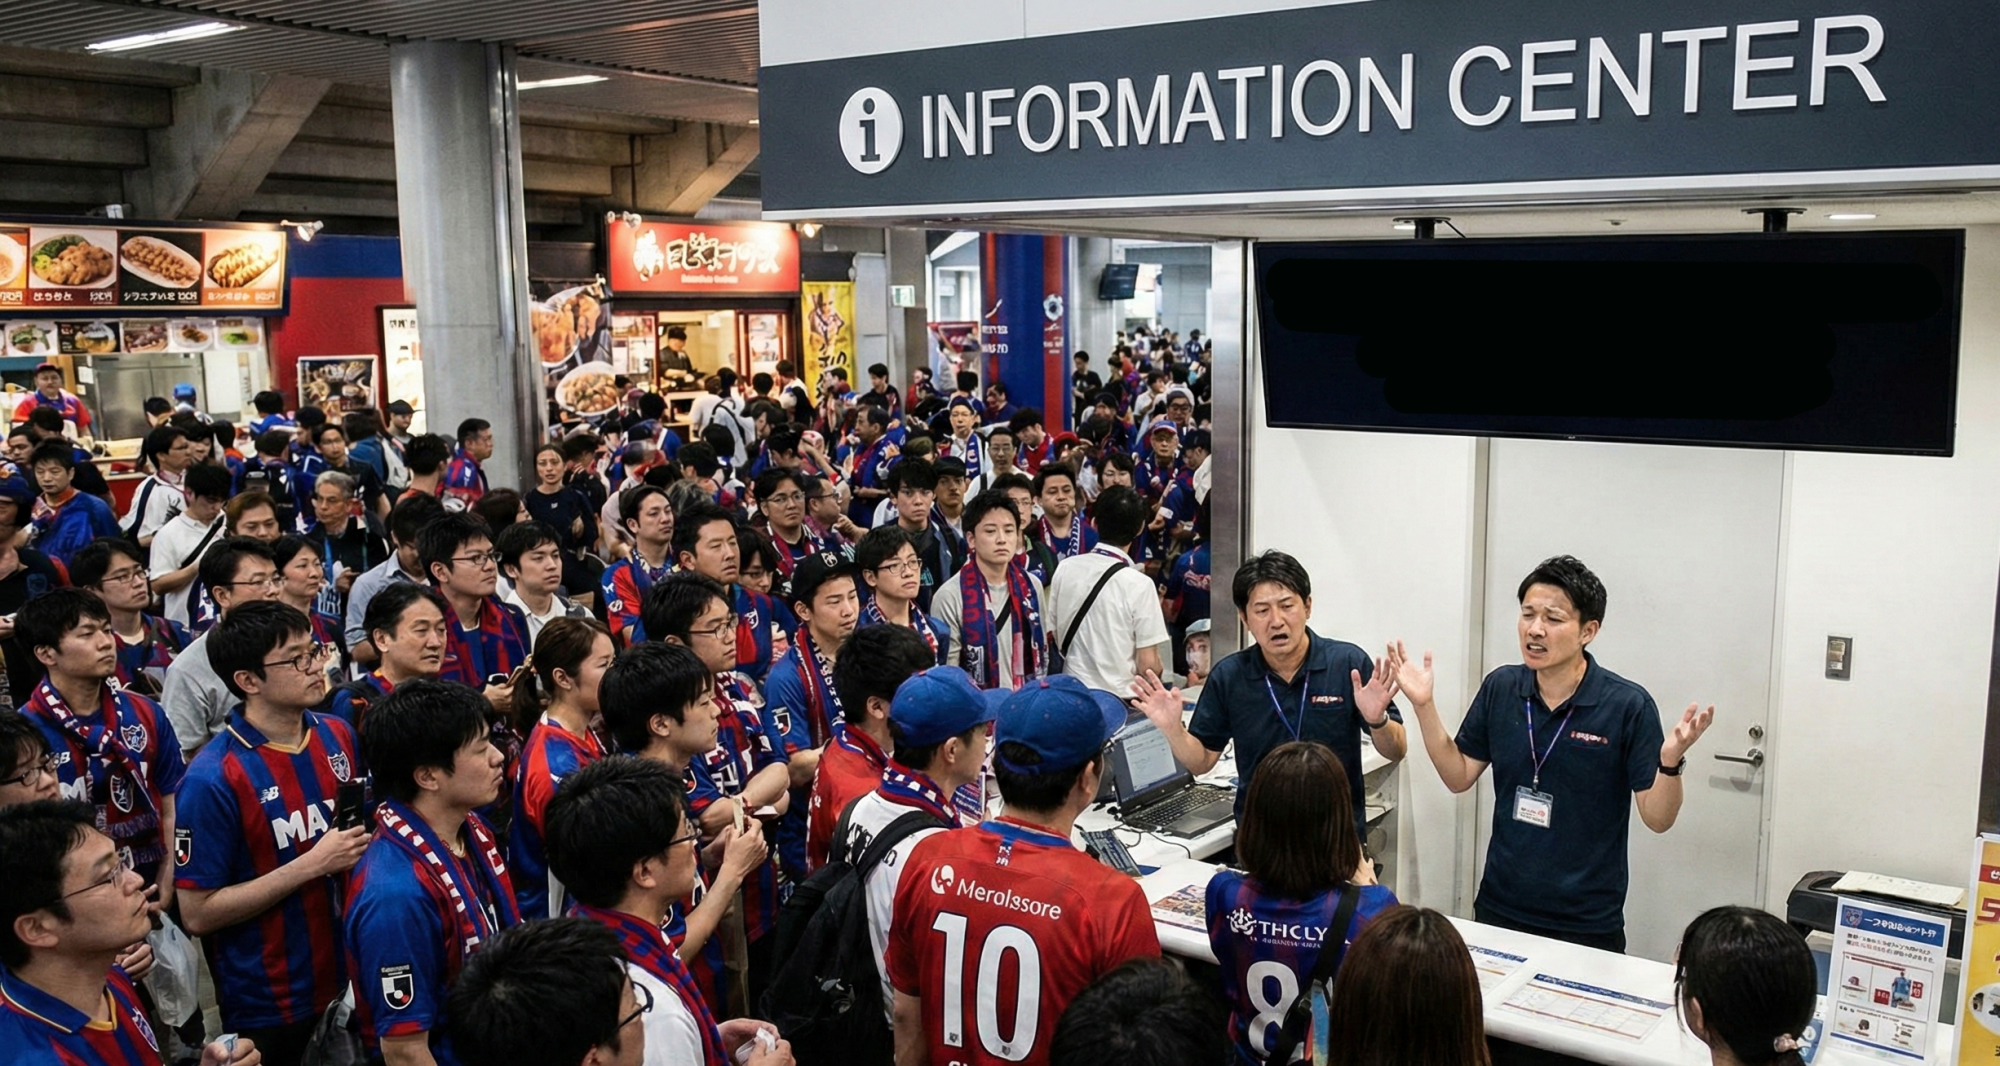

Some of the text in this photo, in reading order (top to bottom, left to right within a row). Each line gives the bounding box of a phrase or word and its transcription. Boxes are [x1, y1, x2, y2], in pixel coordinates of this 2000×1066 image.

[922, 53, 1414, 160] INFORMATION
[1448, 13, 1888, 127] CENTER
[931, 911, 1040, 1061] 10
